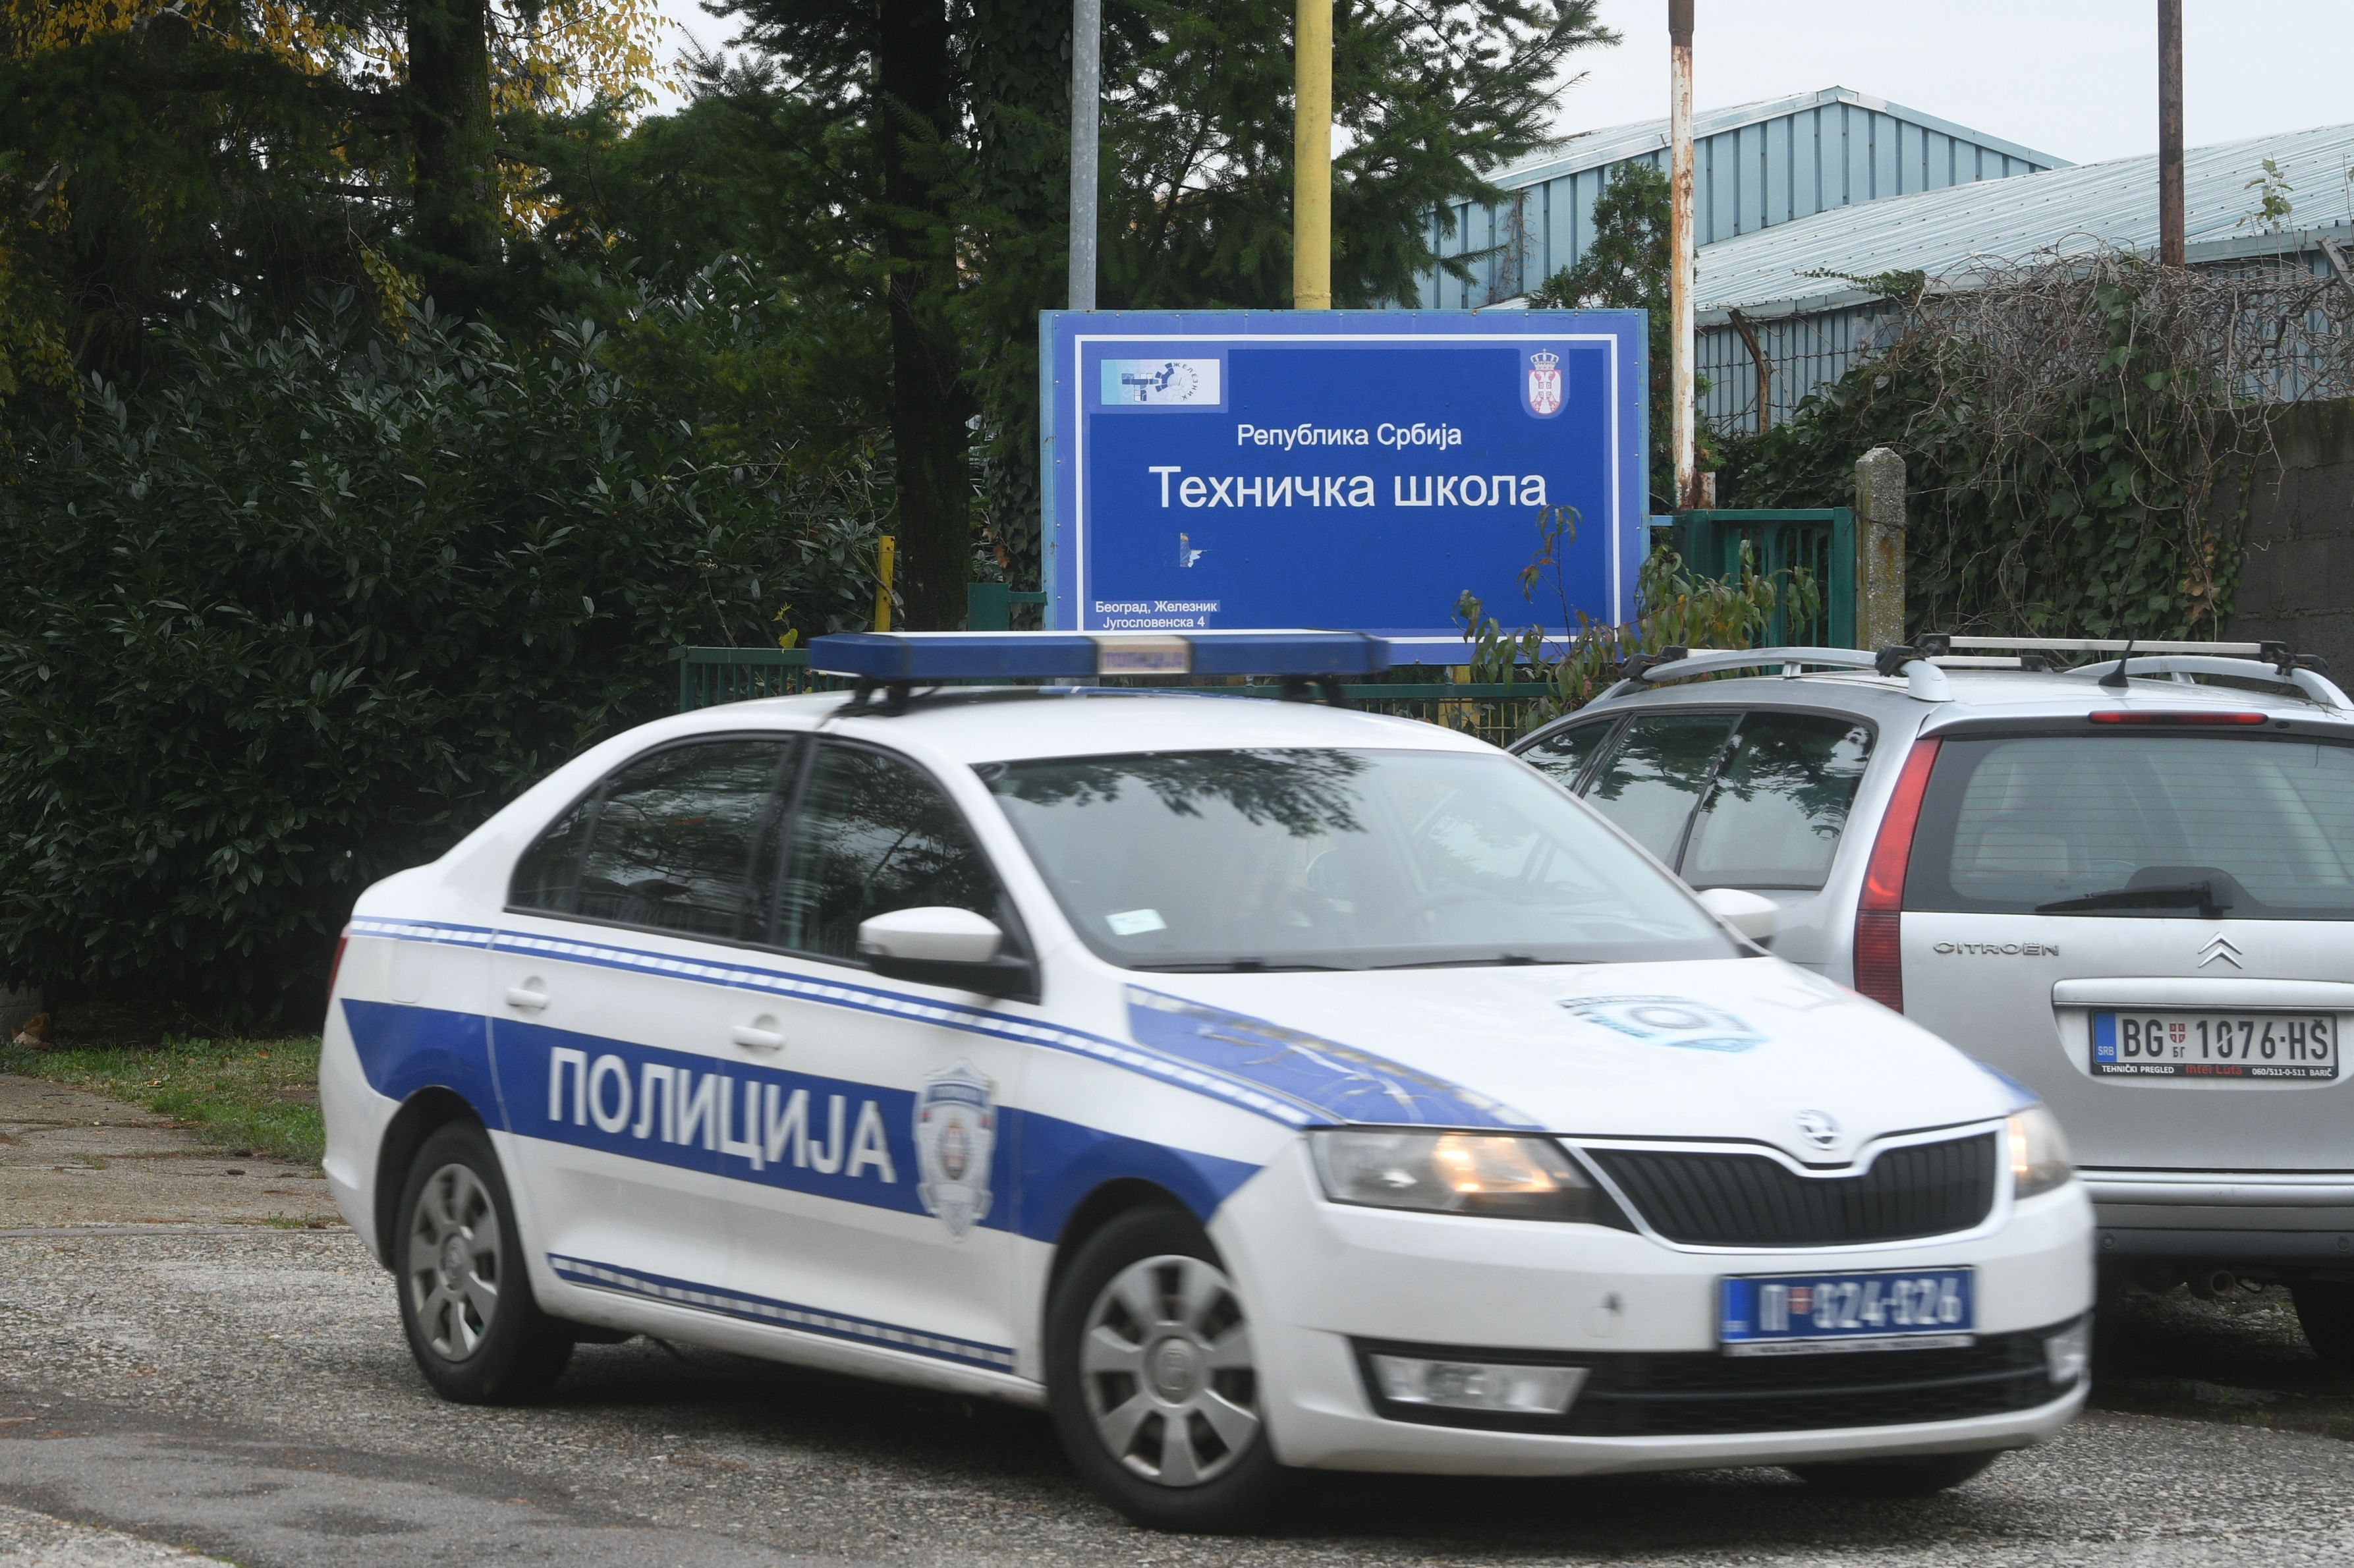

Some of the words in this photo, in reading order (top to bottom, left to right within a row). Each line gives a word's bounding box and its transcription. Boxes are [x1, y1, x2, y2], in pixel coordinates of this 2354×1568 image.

[1173, 362, 1198, 401] ЖЕЛЕЗНИК
[1237, 423, 1369, 451] Република
[1377, 423, 1462, 451] Србија
[1148, 465, 1376, 508] Техничка
[1394, 473, 1547, 507] школа
[1095, 601, 1151, 615] Београд,
[1154, 600, 1218, 612] Железник
[1103, 617, 1194, 630] Југословенска
[1196, 615, 1205, 627] 4
[1934, 941, 2060, 957] CITROËN
[2097, 1046, 2114, 1055] SRB
[2122, 1018, 2164, 1057] BG
[2102, 1064, 2138, 1073] TEHNIČKI
[2141, 1065, 2174, 1074] PREGLED
[2185, 1064, 2212, 1075] Inter
[2216, 1065, 2243, 1075] Luta
[2309, 1068, 2332, 1077] BARIČ
[547, 1046, 898, 1184] ПОЛИЦИЈА
